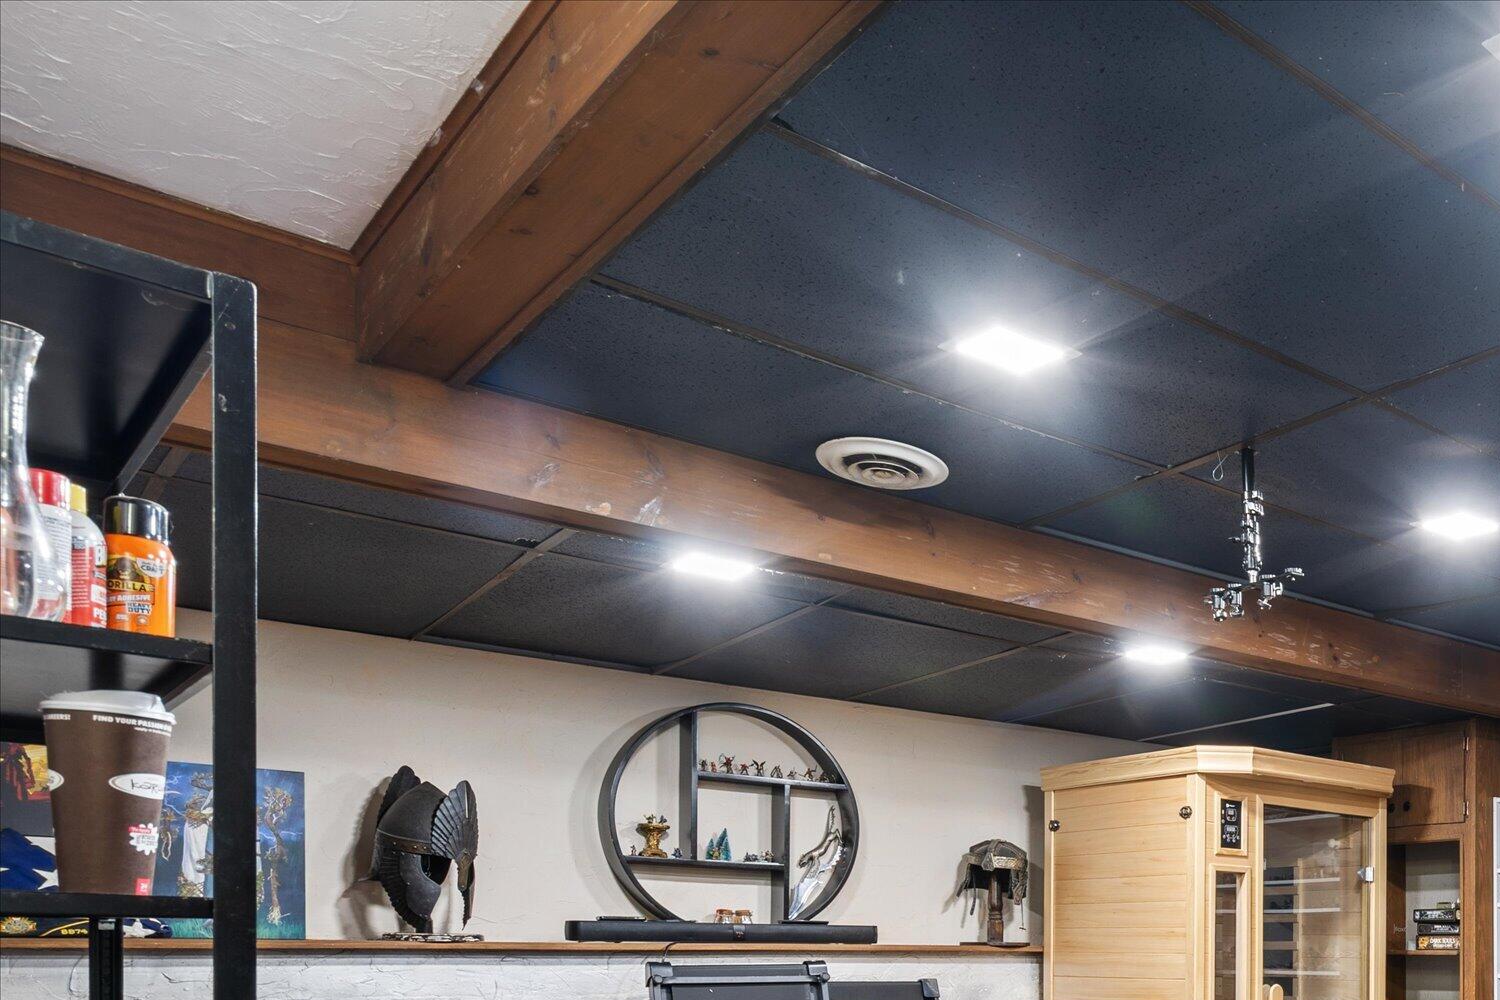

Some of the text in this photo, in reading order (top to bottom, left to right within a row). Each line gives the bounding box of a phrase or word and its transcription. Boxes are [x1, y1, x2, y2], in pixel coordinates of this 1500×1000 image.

[107, 580, 147, 593] ORILLA
[127, 606, 152, 615] DUTY
[93, 714, 114, 723] FIND
[115, 717, 137, 726] YOUR
